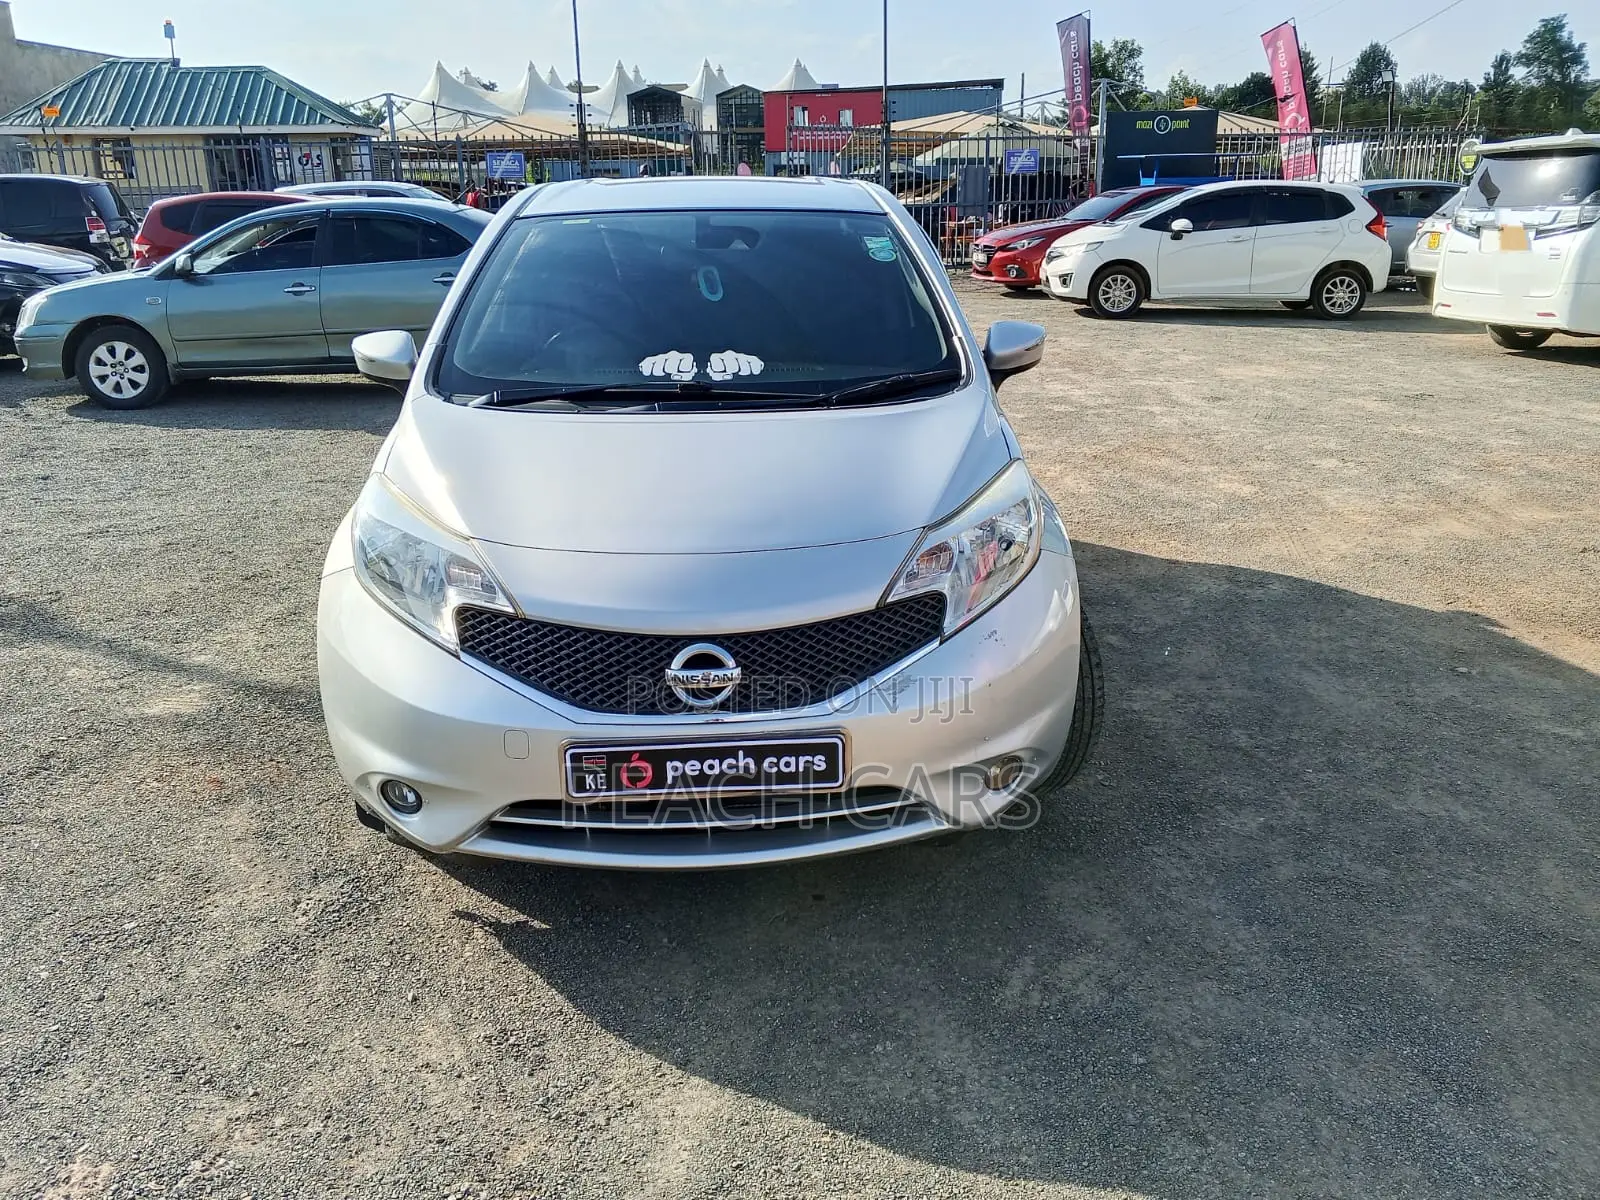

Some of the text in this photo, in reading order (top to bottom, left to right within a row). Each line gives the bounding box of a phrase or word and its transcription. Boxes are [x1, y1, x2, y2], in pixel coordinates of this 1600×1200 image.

[672, 672, 734, 686] NISSAN
[666, 750, 827, 784] peach cars
[585, 773, 607, 790] KE
